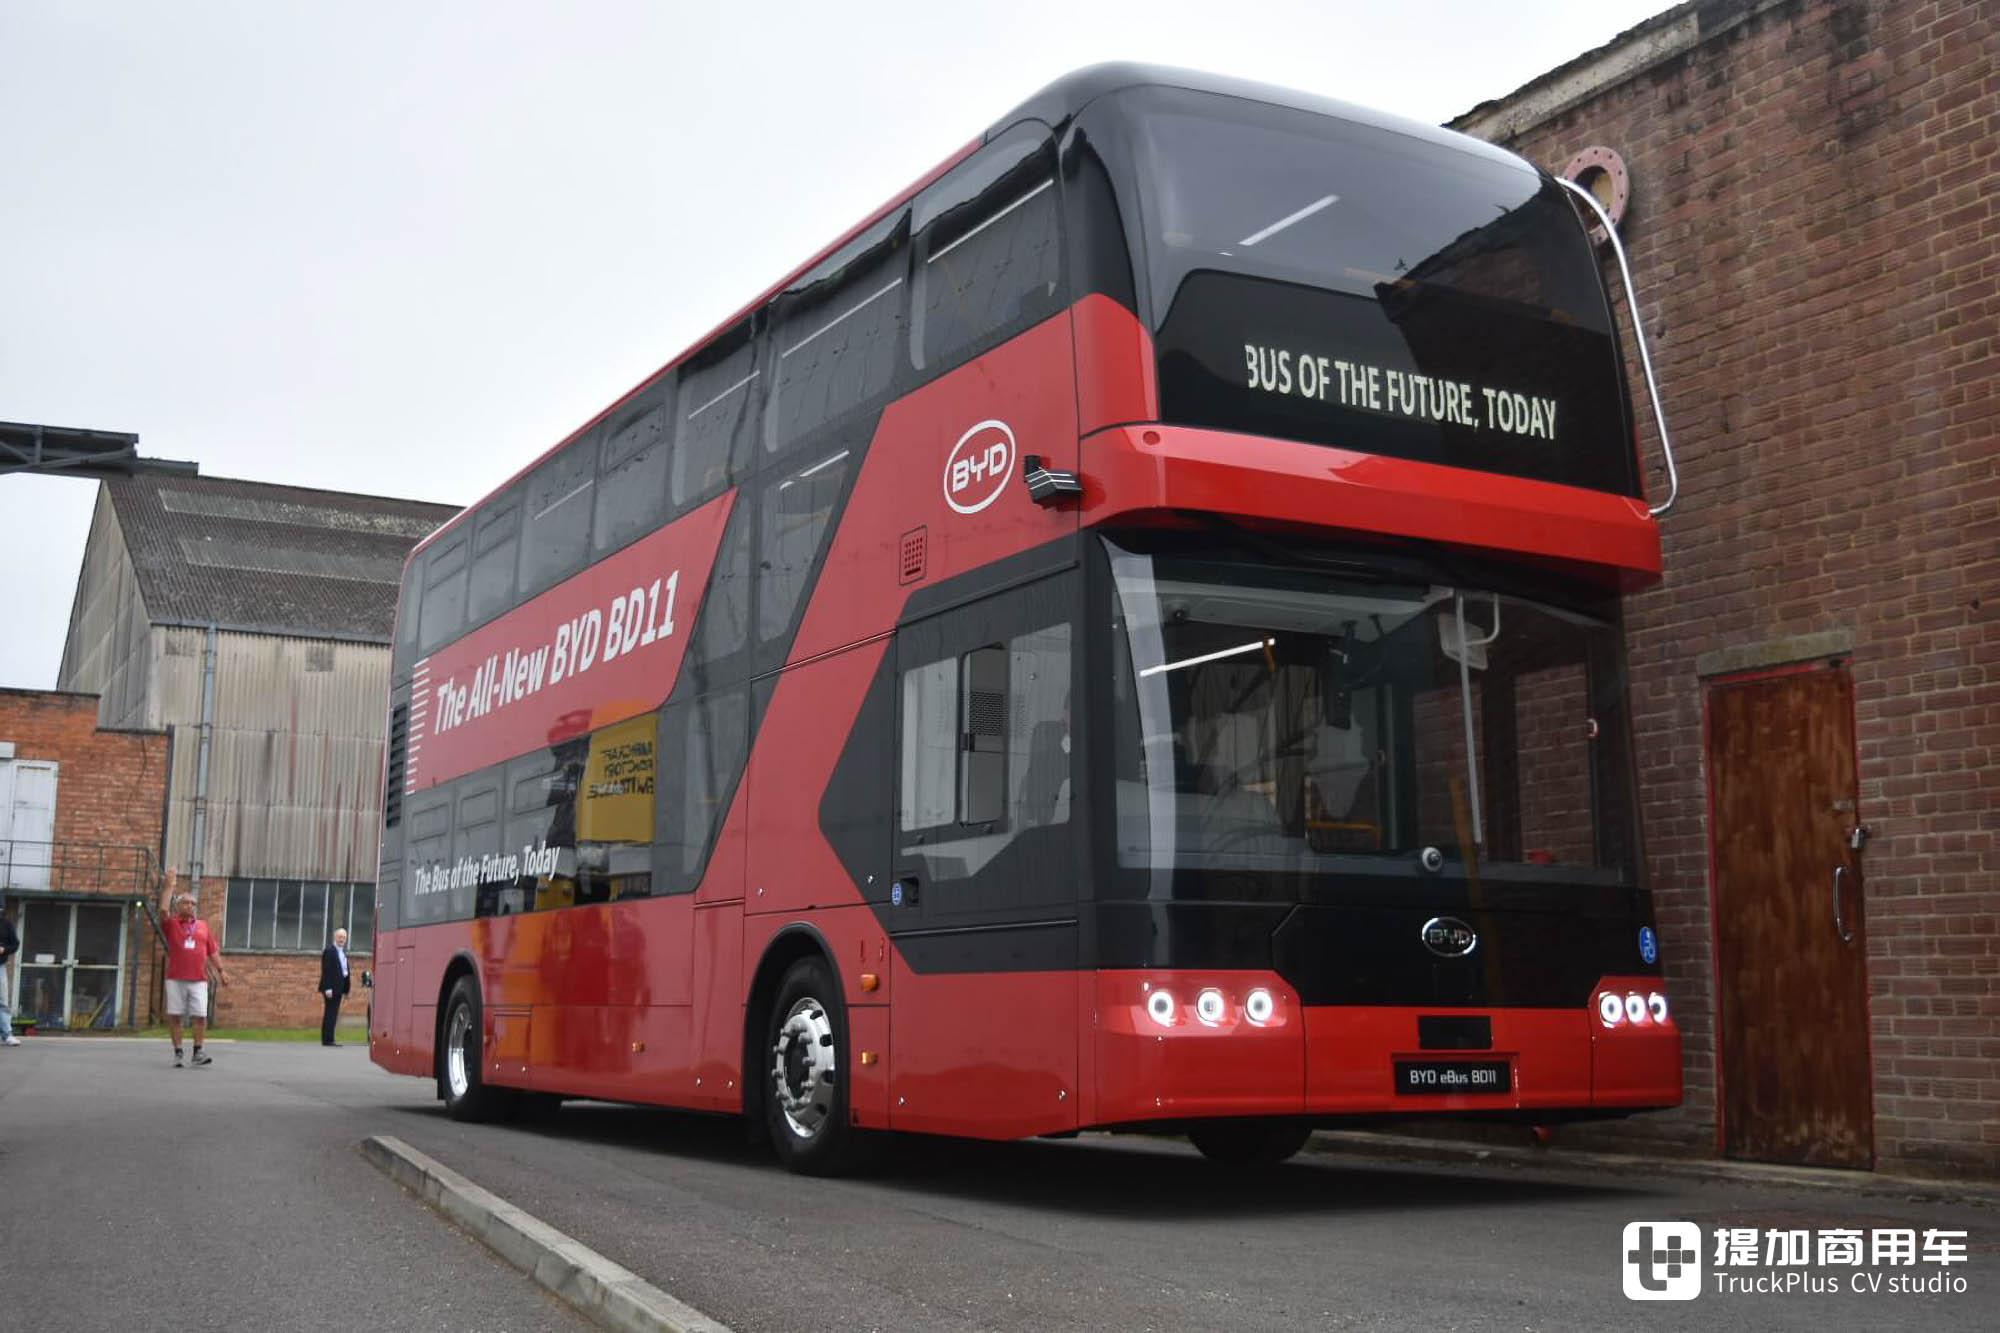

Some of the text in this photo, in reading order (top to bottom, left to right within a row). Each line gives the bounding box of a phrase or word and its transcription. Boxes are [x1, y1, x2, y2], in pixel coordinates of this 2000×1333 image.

[1245, 344, 1557, 440] BUS OF THE FUTURE, TODAY
[952, 442, 1008, 493] BYD
[434, 570, 679, 735] The All-New BYD BD11
[415, 841, 561, 895] The Bus of the Future, Today
[1410, 1069, 1497, 1084] BYD eBus BD11
